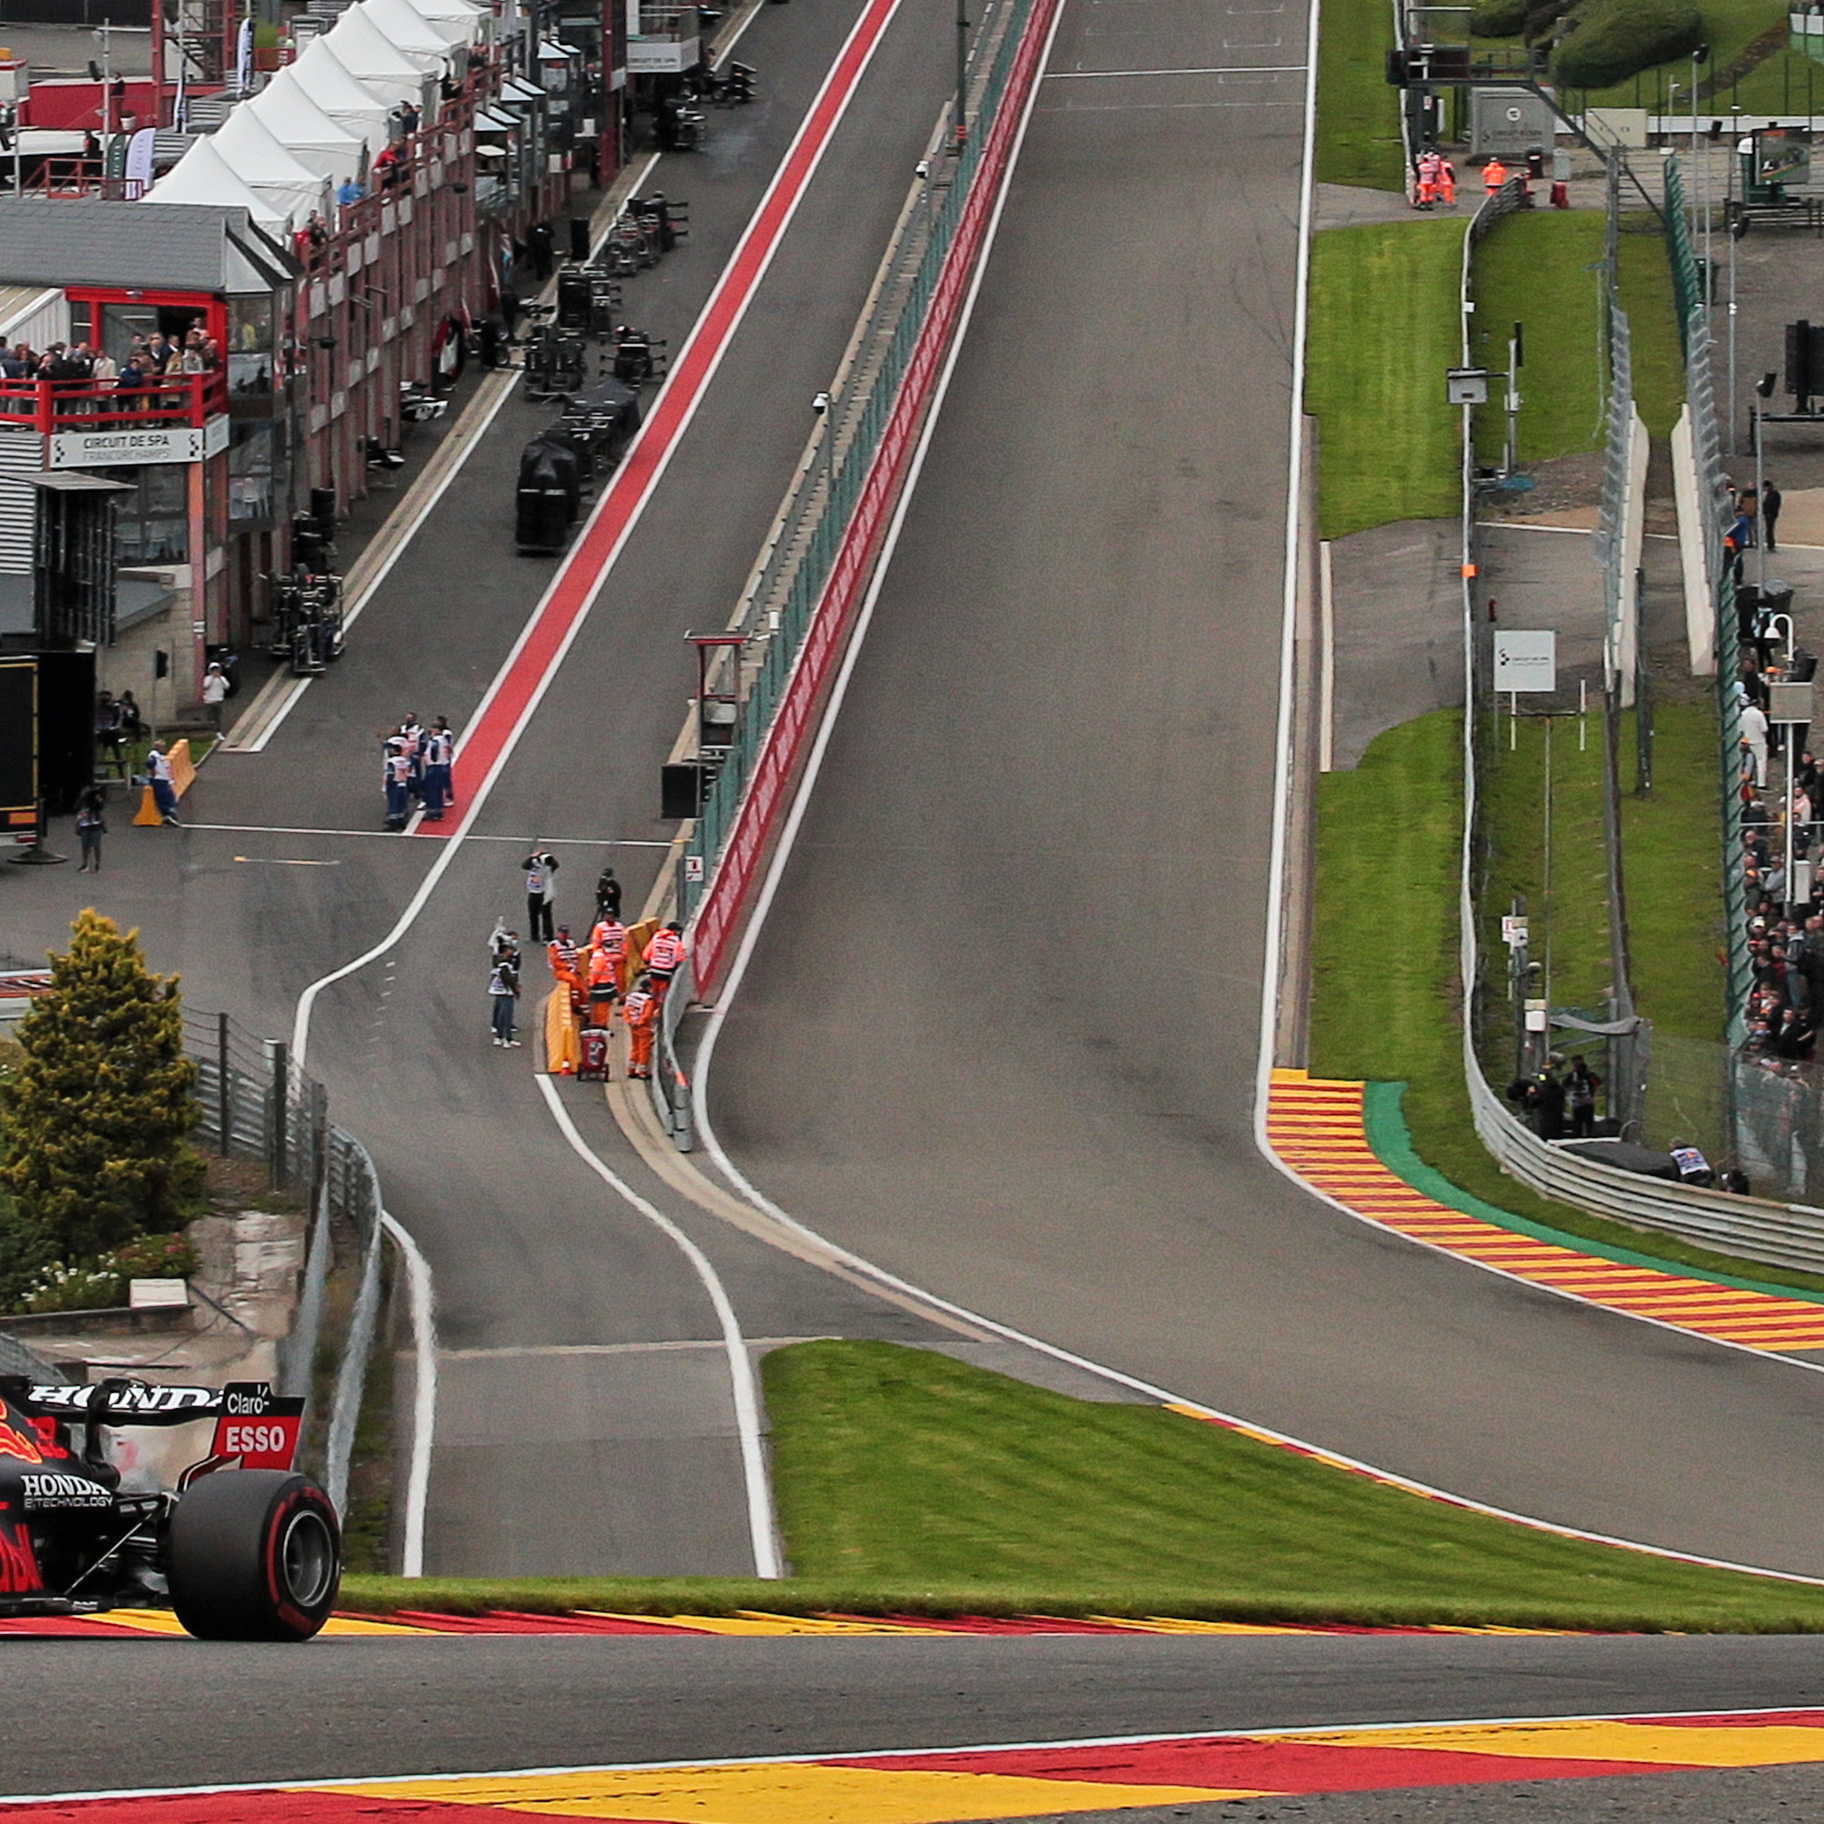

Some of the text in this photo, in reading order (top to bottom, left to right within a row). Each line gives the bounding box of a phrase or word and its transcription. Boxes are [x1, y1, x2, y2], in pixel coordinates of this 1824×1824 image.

[83, 435, 170, 449] CIRCUIT DE SPA
[226, 1386, 265, 1415] Claro
[226, 1426, 286, 1453] ESSO
[19, 1475, 112, 1497] HONDA
